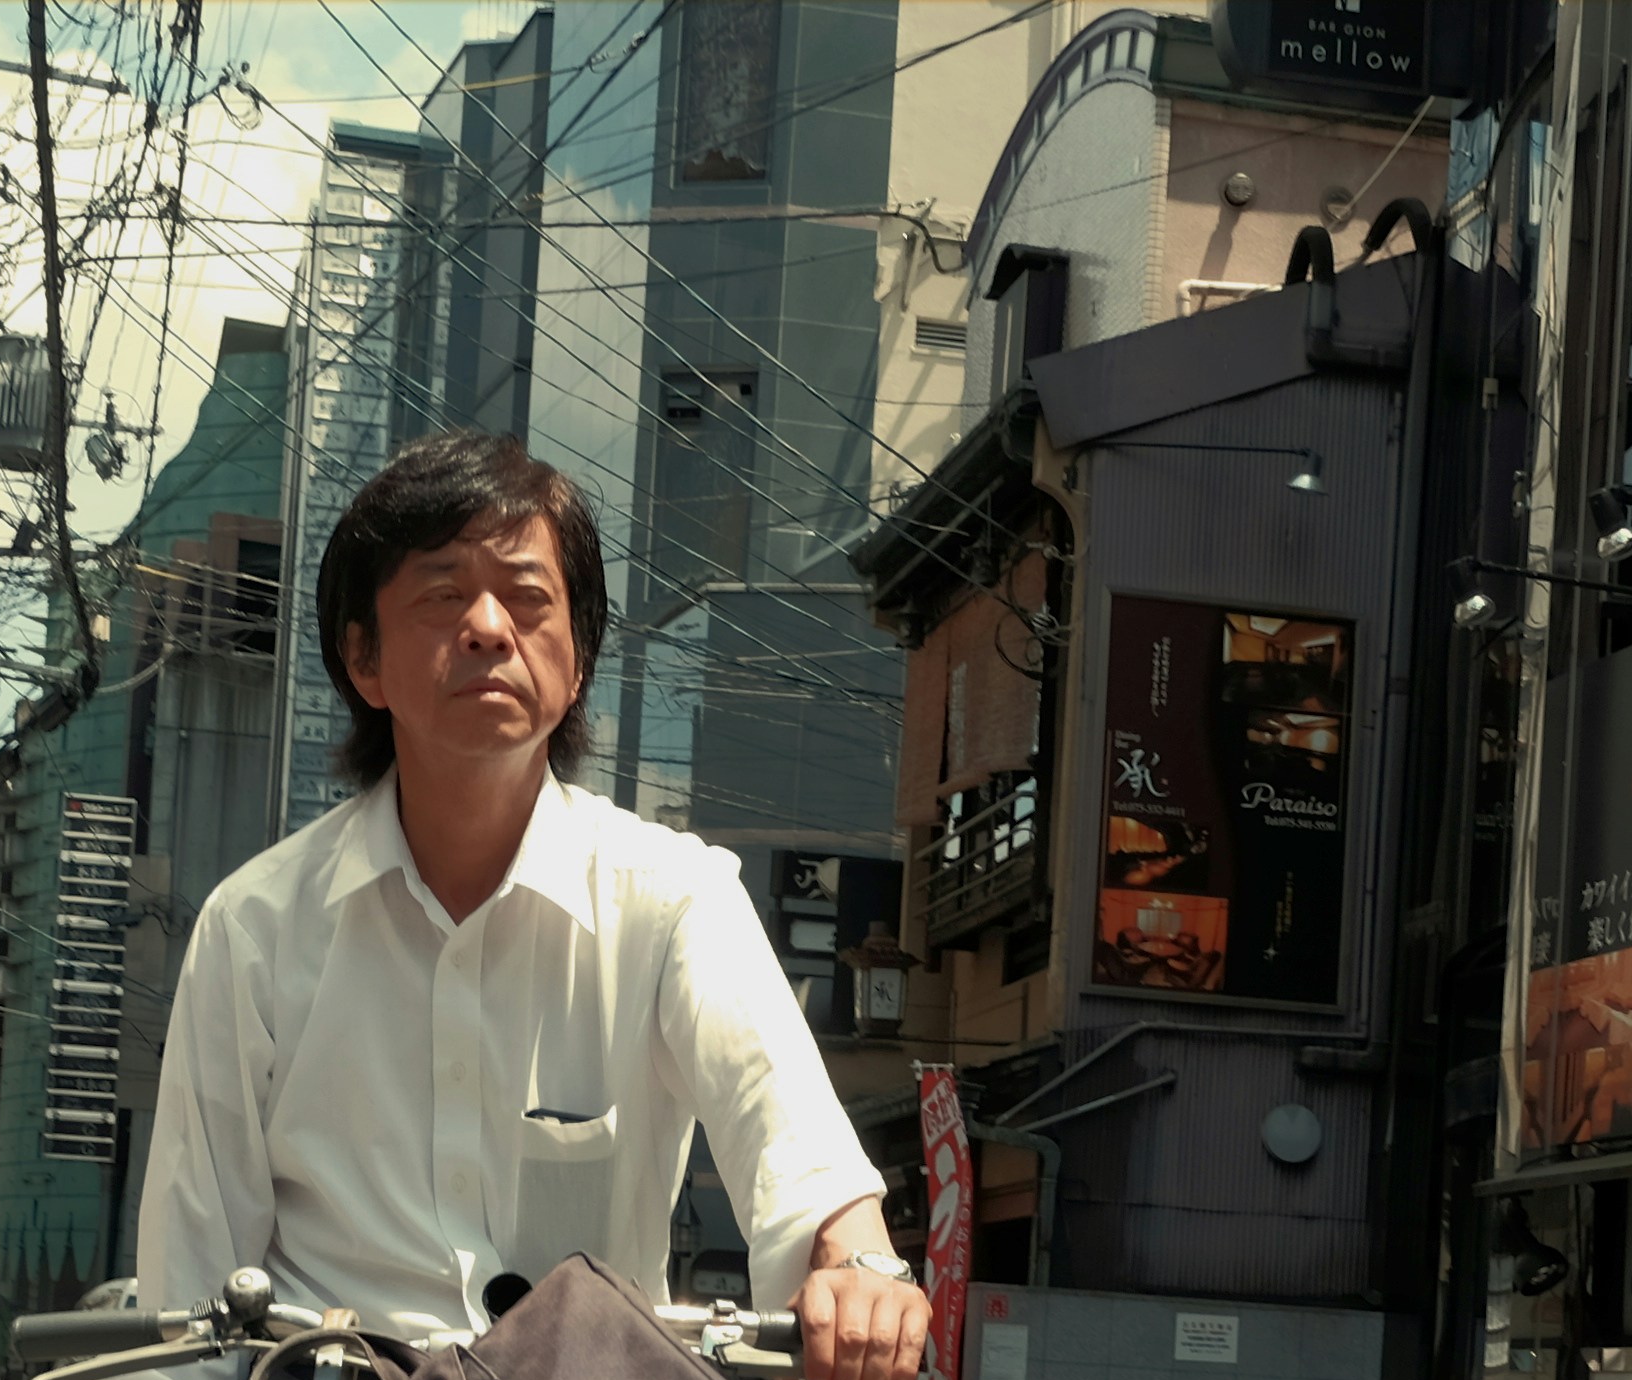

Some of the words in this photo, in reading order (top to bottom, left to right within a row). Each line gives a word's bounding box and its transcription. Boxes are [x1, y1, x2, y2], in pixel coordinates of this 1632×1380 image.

[1308, 18, 1336, 33] BAR
[1343, 22, 1386, 39] GION
[1281, 38, 1410, 73] mellow
[1241, 782, 1338, 817] Paraiso
